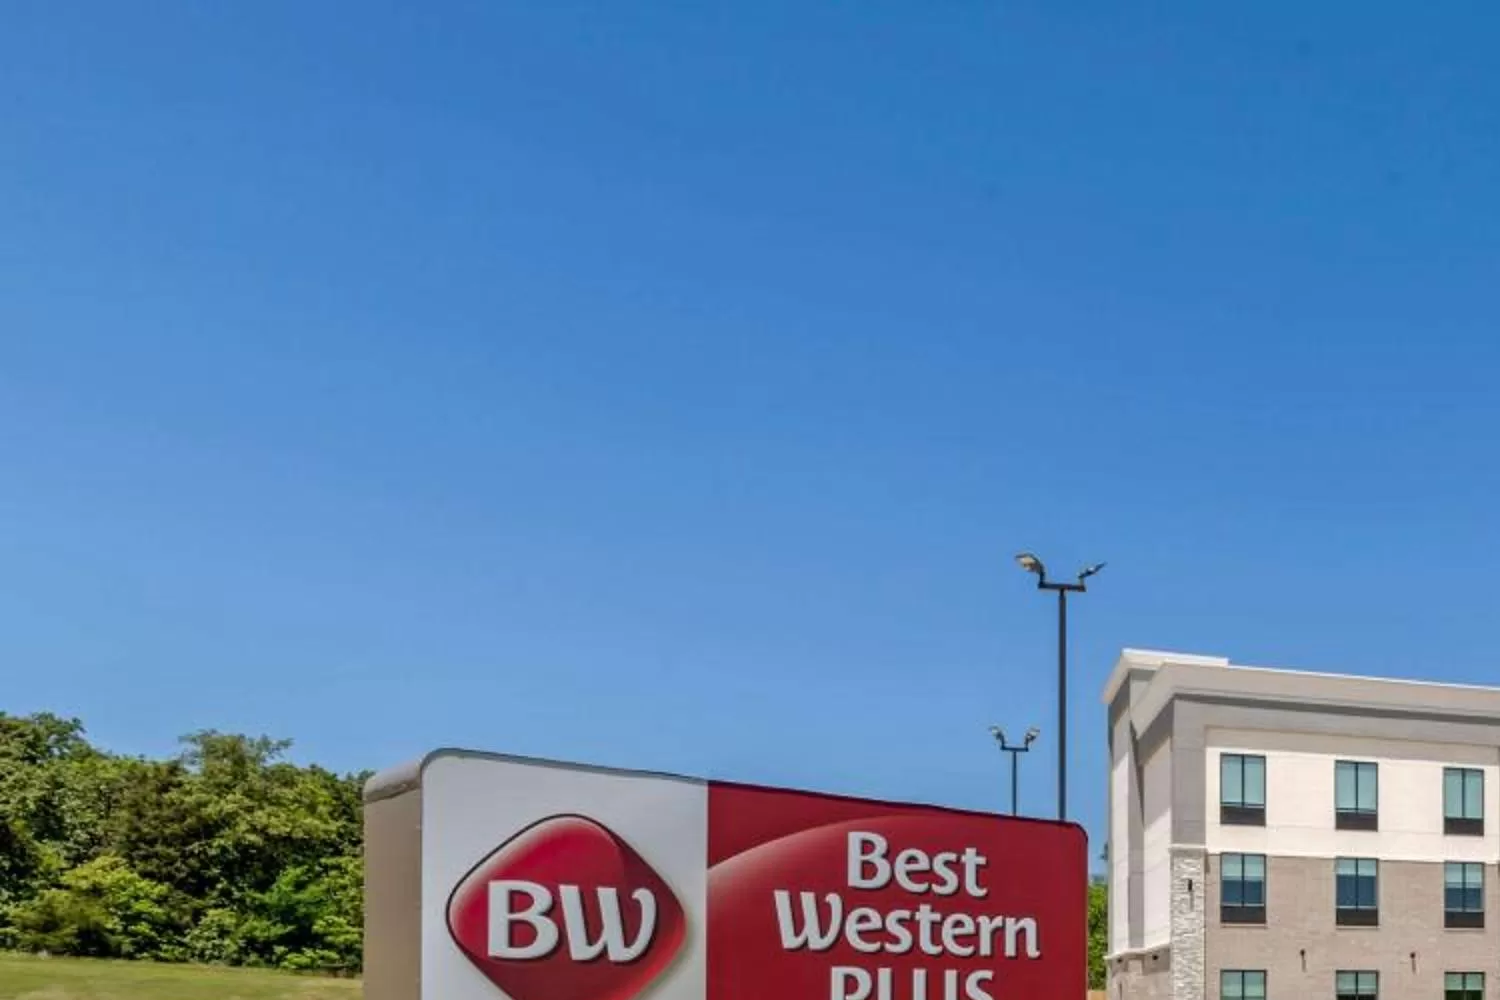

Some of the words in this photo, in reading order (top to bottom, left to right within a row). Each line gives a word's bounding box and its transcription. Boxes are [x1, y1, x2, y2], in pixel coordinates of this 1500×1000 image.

[847, 831, 988, 897] Best
[487, 879, 656, 962] BW
[774, 890, 1040, 959] Western
